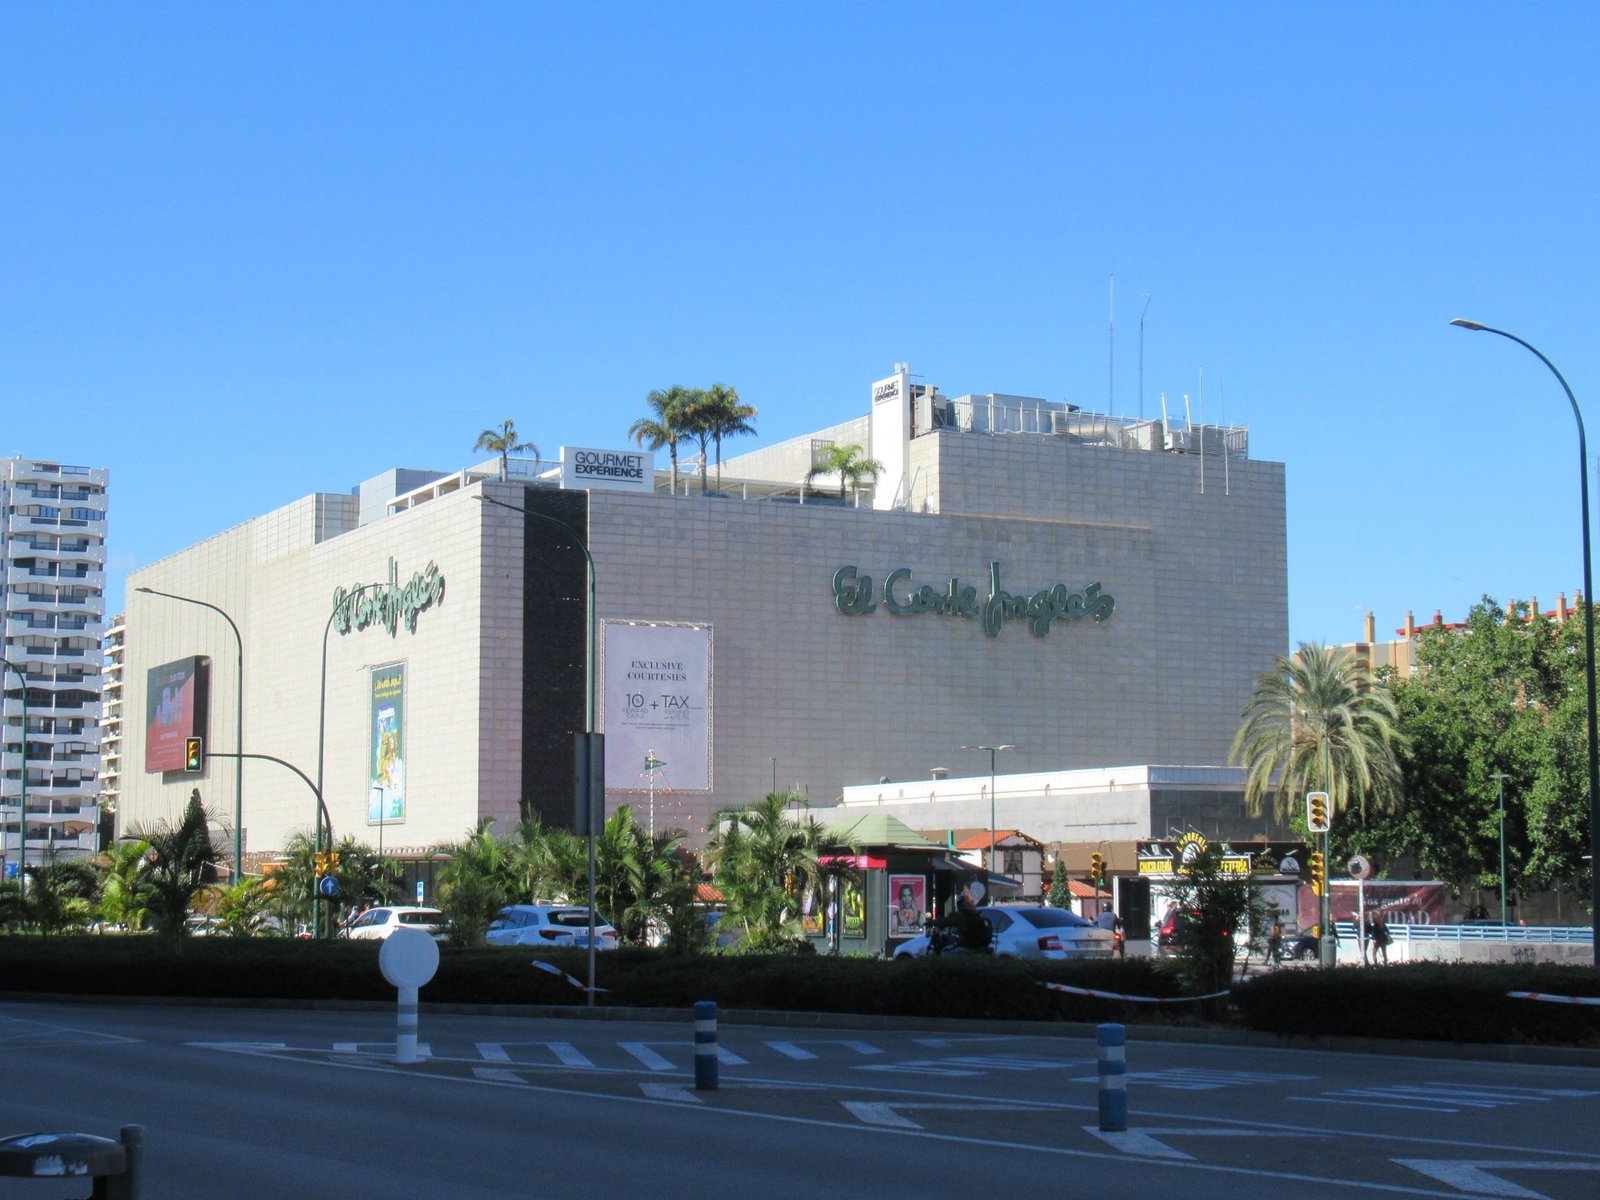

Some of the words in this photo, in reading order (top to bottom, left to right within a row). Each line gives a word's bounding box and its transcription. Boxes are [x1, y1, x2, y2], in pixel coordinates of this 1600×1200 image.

[875, 380, 899, 396] GOURMET
[875, 389, 899, 402] EXPERIENCE
[575, 451, 644, 468] GOURMET
[575, 465, 644, 479] EXPERIENCE
[832, 565, 876, 615] El
[884, 568, 979, 618] Corte
[985, 561, 1116, 638] Inglés
[631, 661, 684, 671] EXCLUSIVE
[627, 672, 687, 681] COURTESIES
[650, 700, 659, 711] +
[660, 695, 690, 709] TAX
